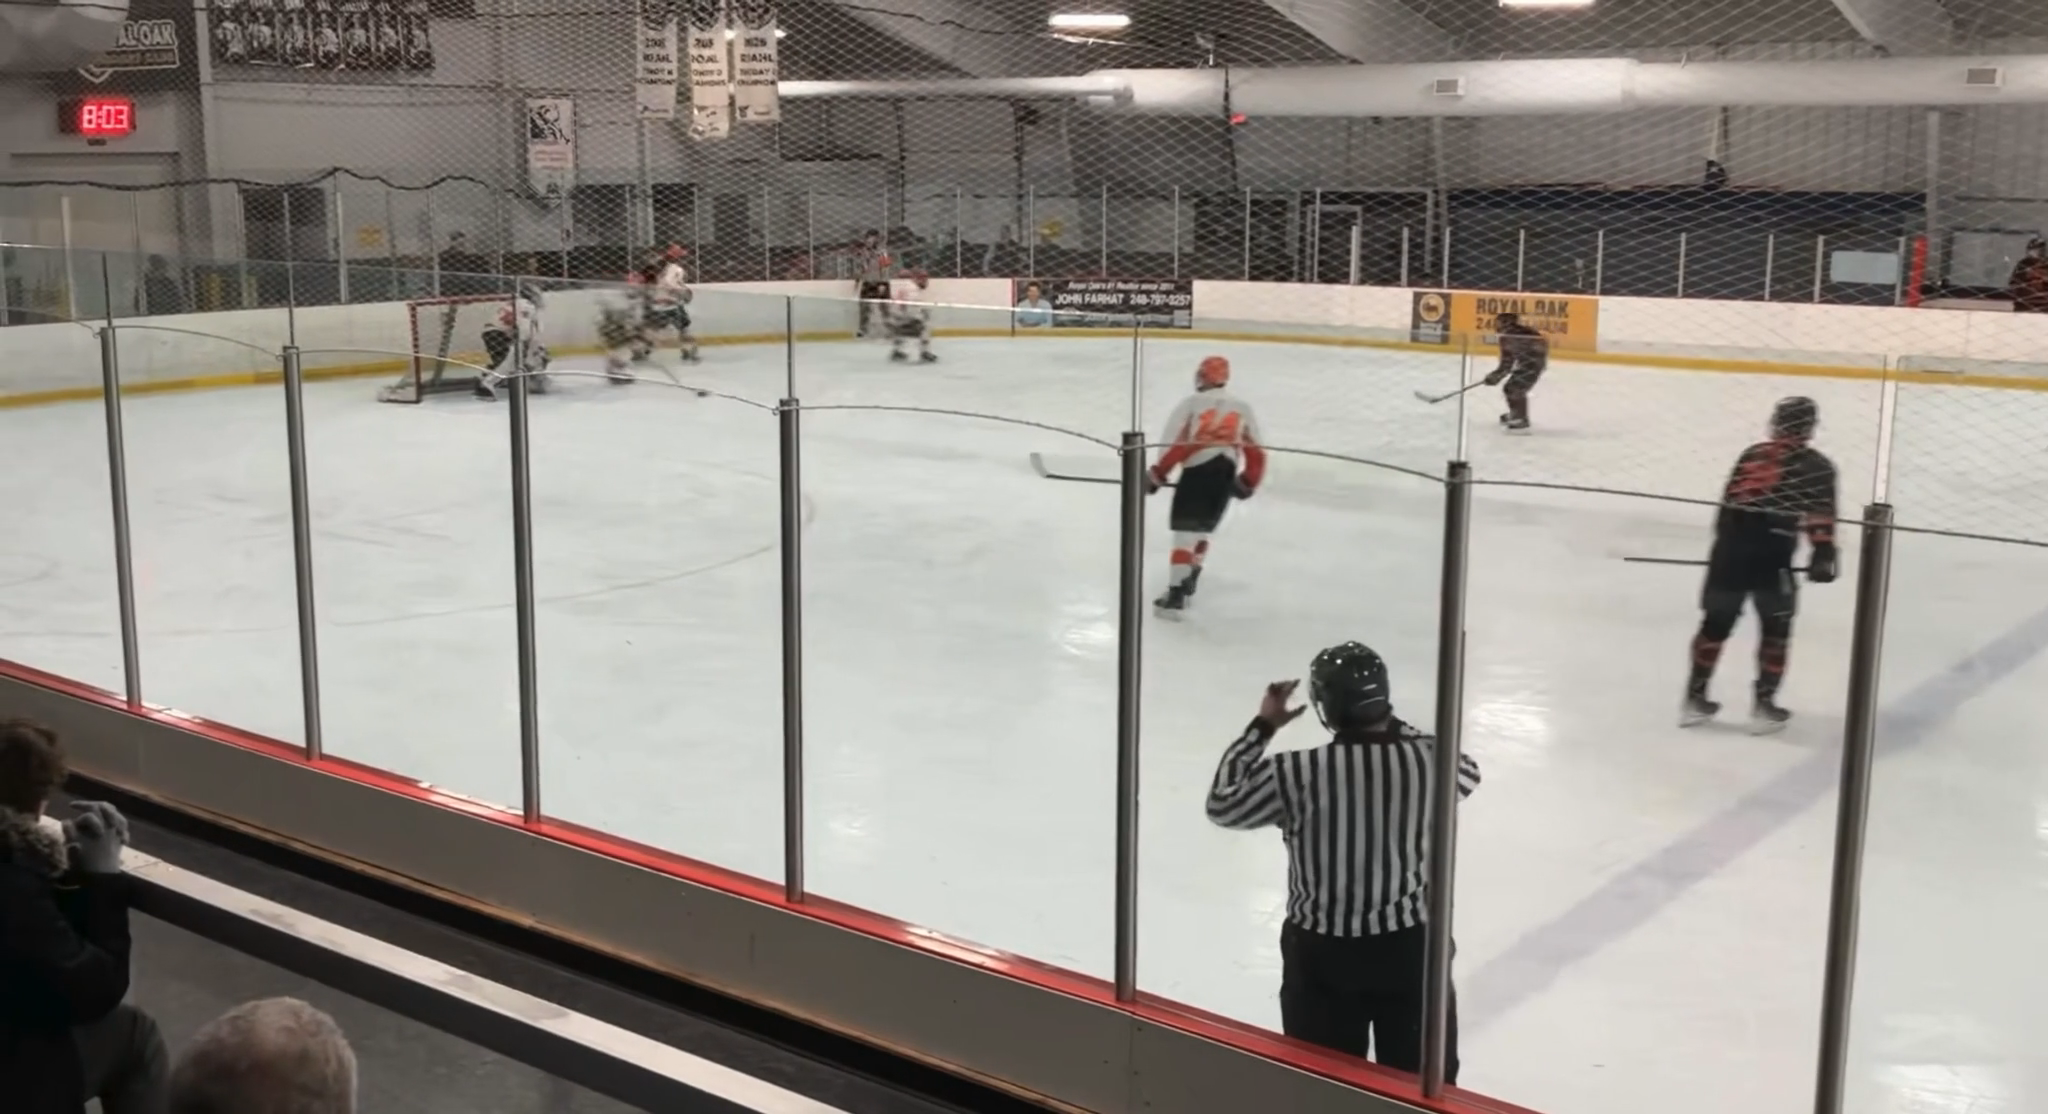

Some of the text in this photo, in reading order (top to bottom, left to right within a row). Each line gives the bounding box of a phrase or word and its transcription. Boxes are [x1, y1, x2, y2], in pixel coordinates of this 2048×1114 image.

[139, 23, 174, 47] OAK
[83, 105, 129, 129] 8:03
[1055, 293, 1083, 305] JOHN
[1084, 293, 1124, 305] FARHAT
[1476, 297, 1569, 318] ROYAL OAK
